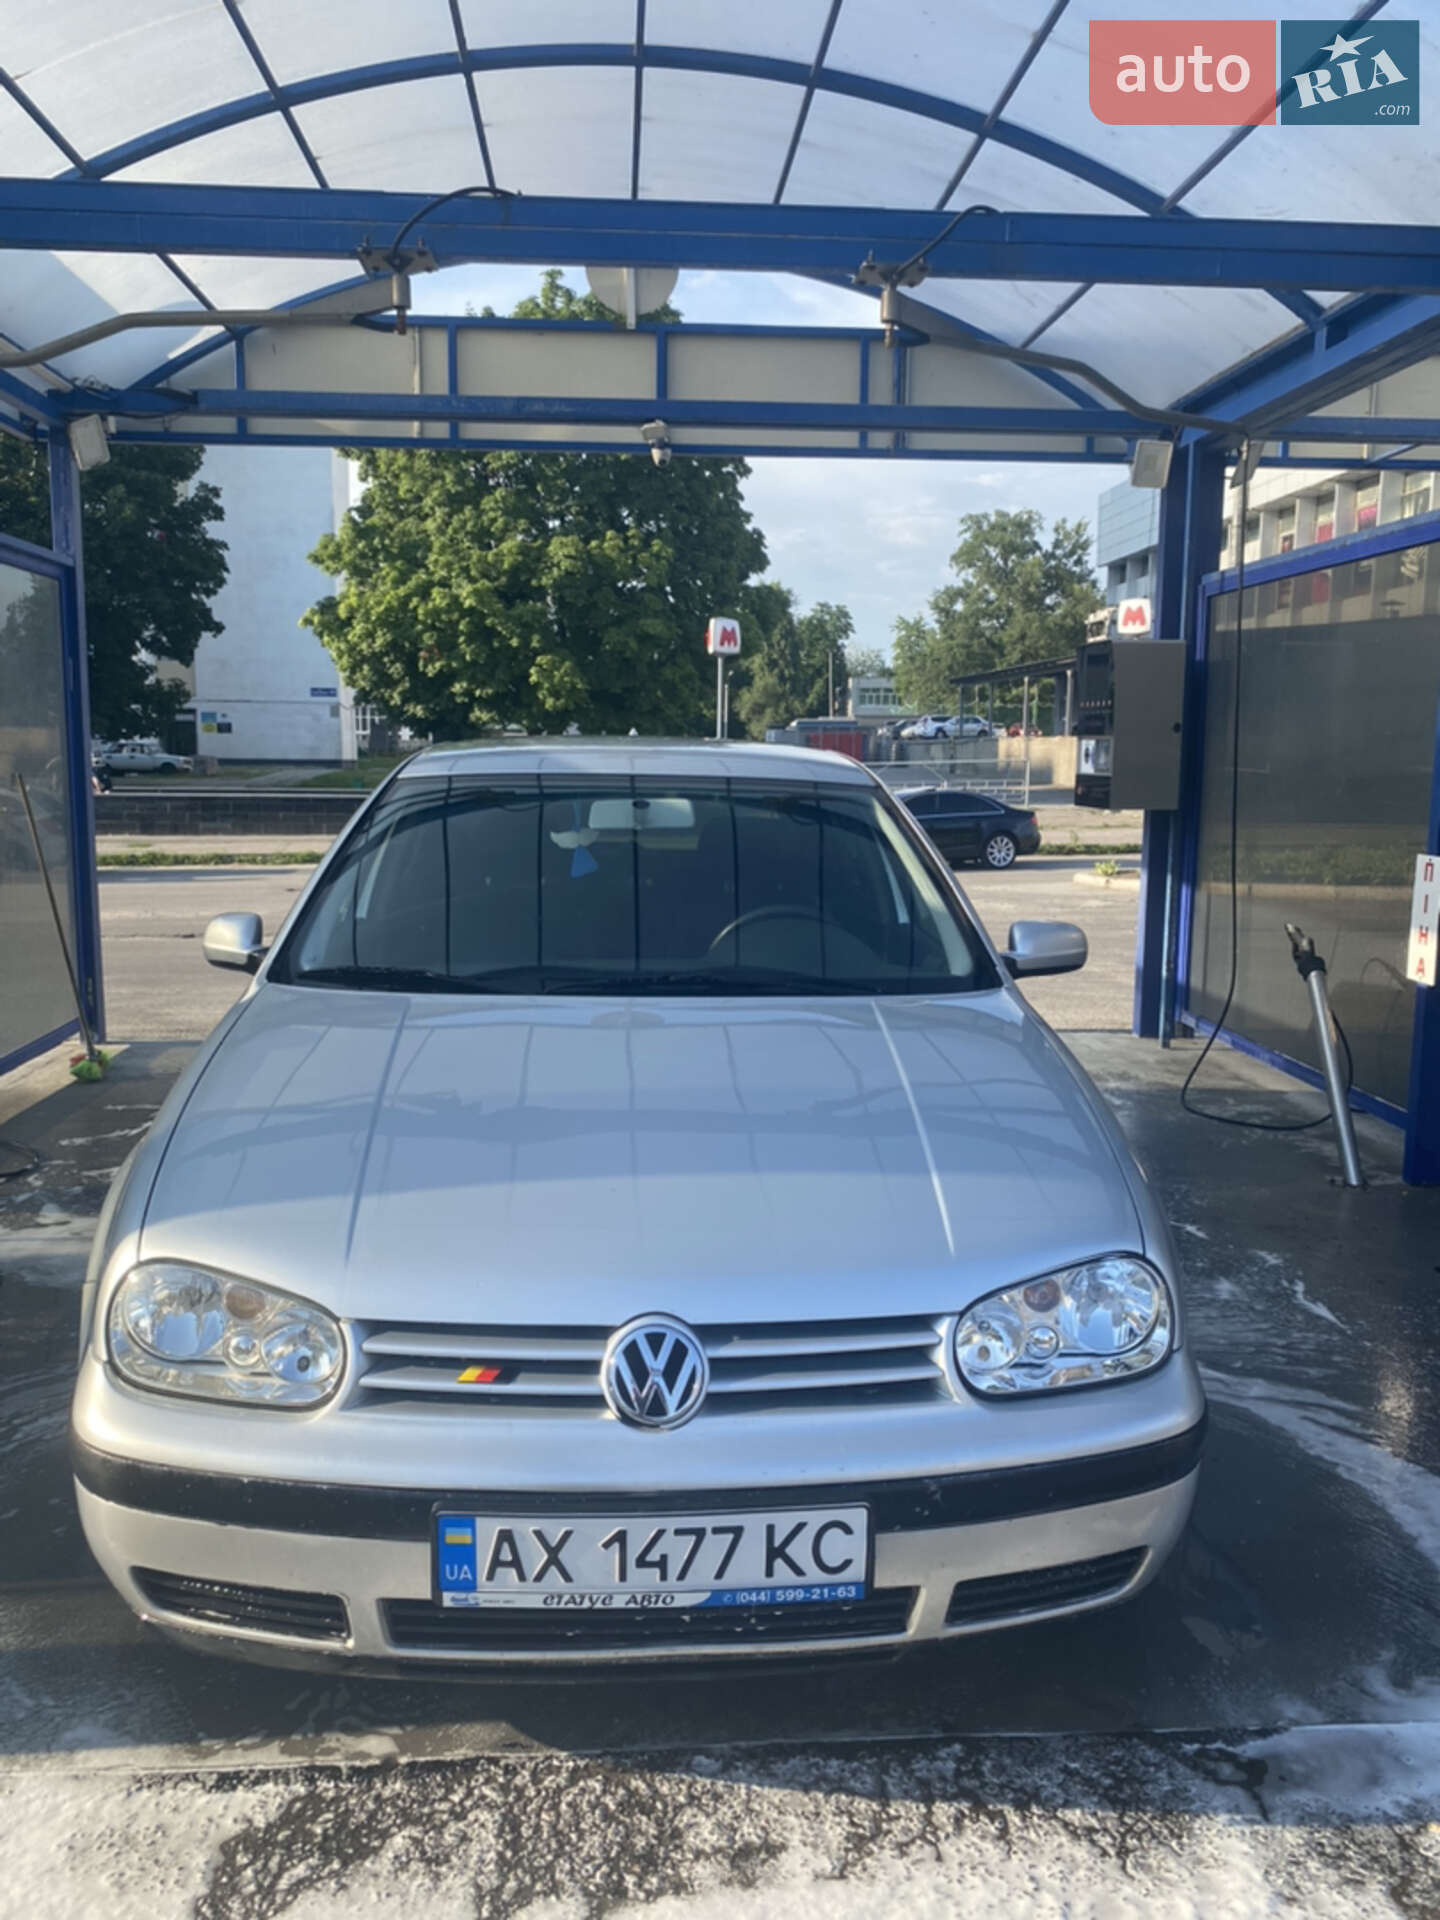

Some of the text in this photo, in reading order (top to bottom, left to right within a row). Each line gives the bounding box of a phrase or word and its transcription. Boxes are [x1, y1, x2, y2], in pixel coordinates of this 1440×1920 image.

[484, 1519, 855, 1583] AX 1477 KC
[445, 1563, 473, 1581] UA
[737, 1586, 857, 1605] (044) 599-21-63
